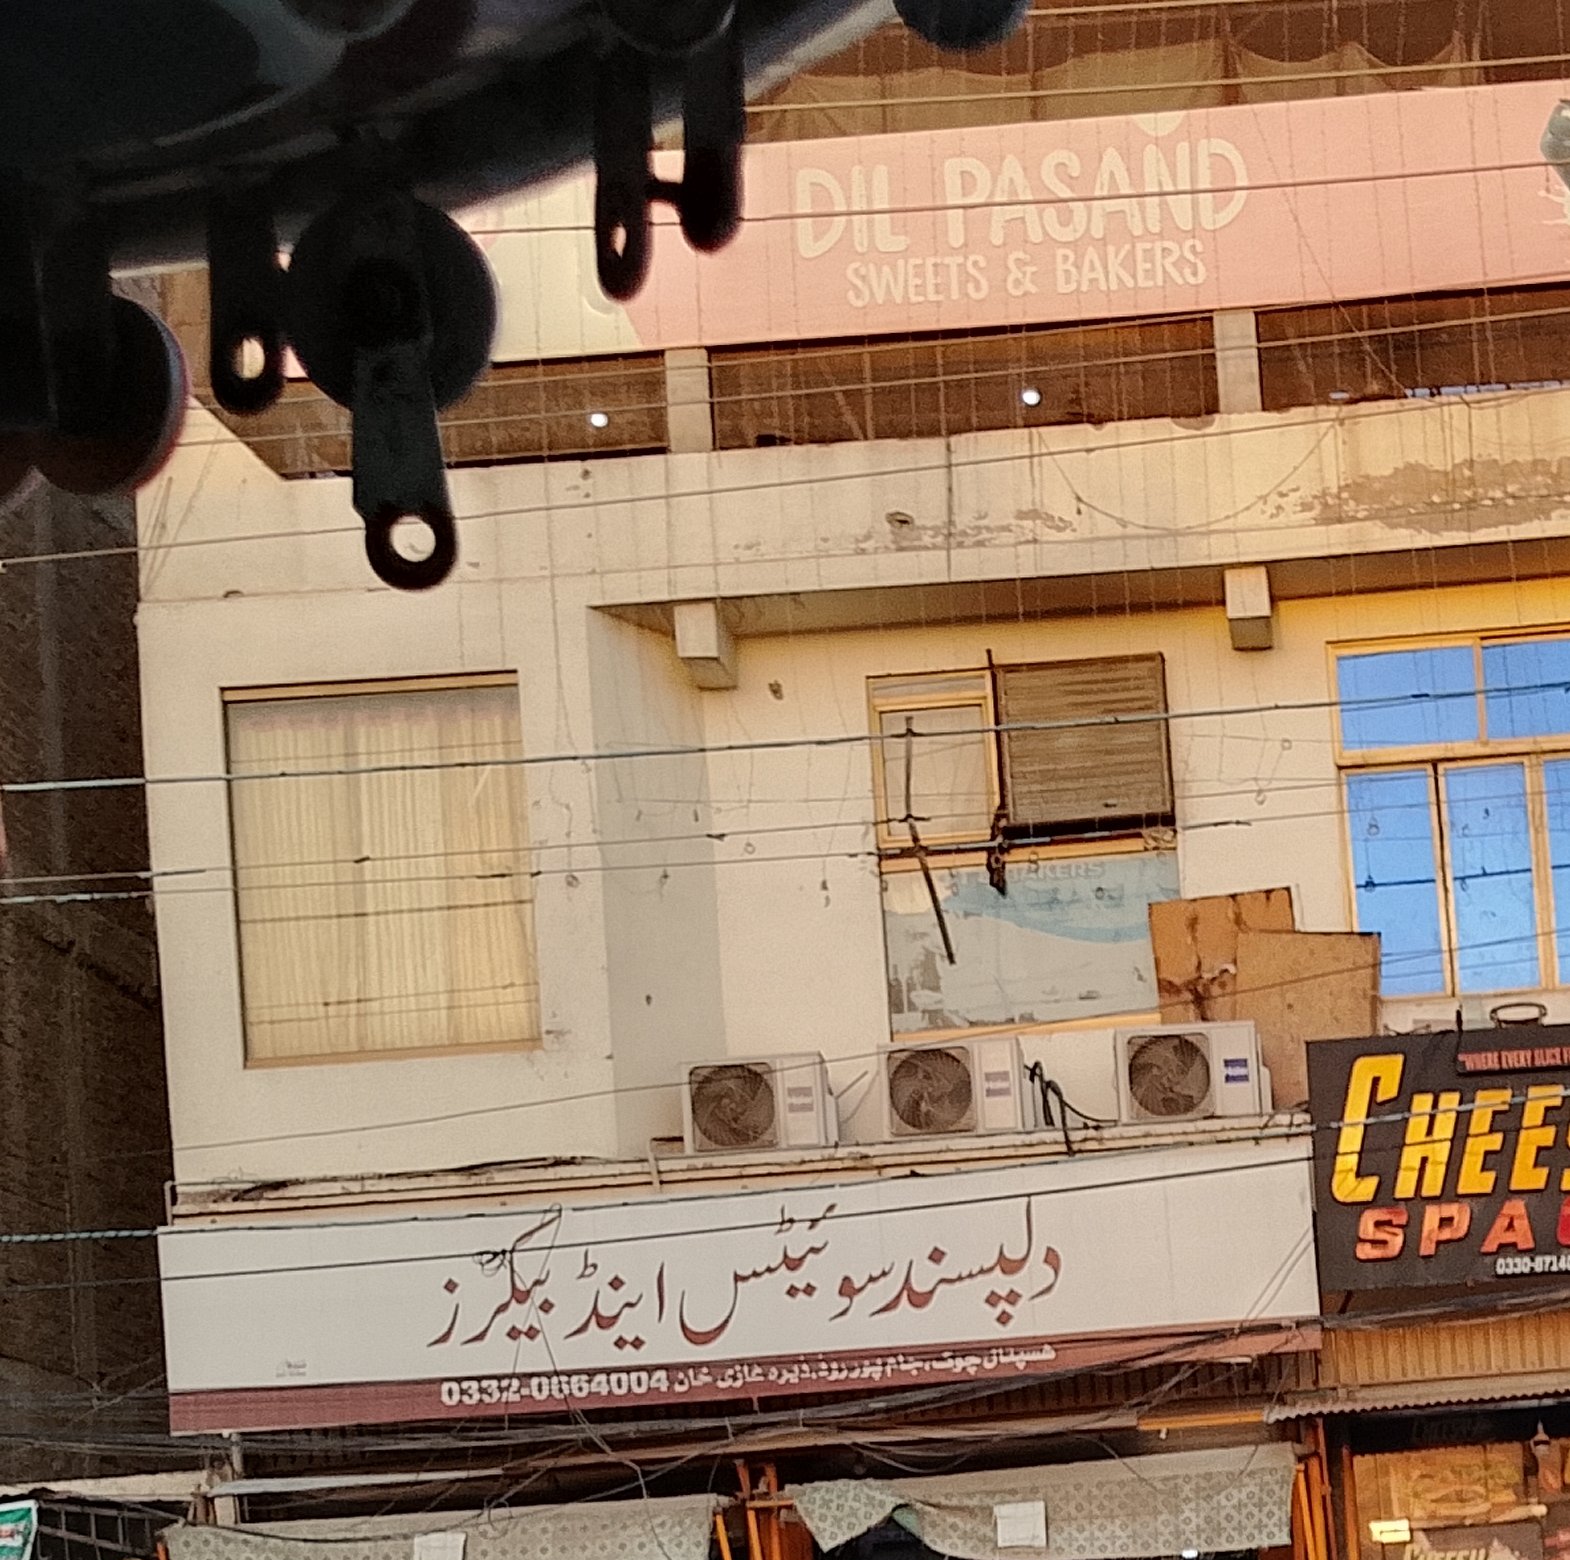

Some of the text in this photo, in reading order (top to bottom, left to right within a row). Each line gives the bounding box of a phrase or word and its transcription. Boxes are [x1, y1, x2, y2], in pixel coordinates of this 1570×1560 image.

[797, 138, 1249, 259] DIL PASAND
[845, 240, 1208, 308] SWEETS & BAKERS
[1331, 1053, 1570, 1203] CHEE
[441, 1369, 669, 1406] 0332-0664004
